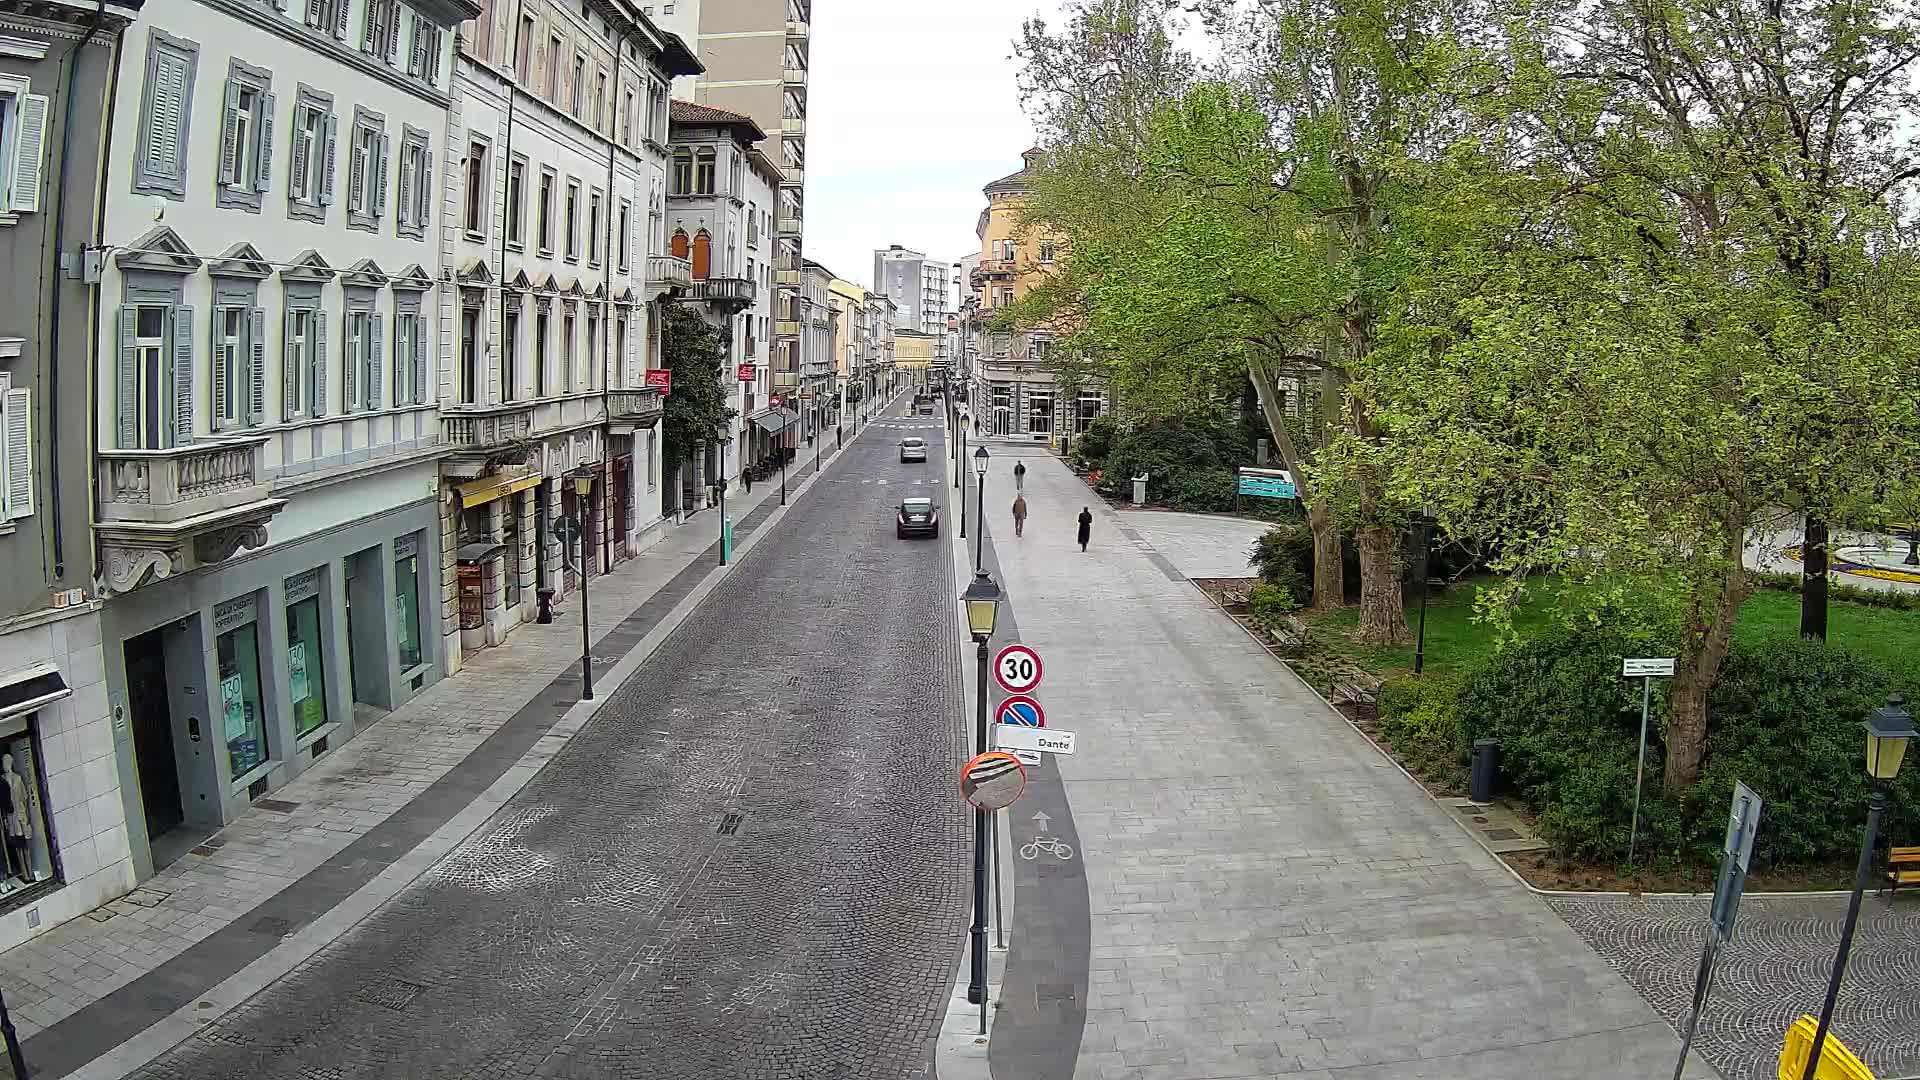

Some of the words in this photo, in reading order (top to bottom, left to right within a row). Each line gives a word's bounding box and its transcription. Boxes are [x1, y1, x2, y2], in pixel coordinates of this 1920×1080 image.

[1005, 659, 1032, 680] 30
[221, 677, 241, 699] 130
[1038, 738, 1069, 749] Dante
